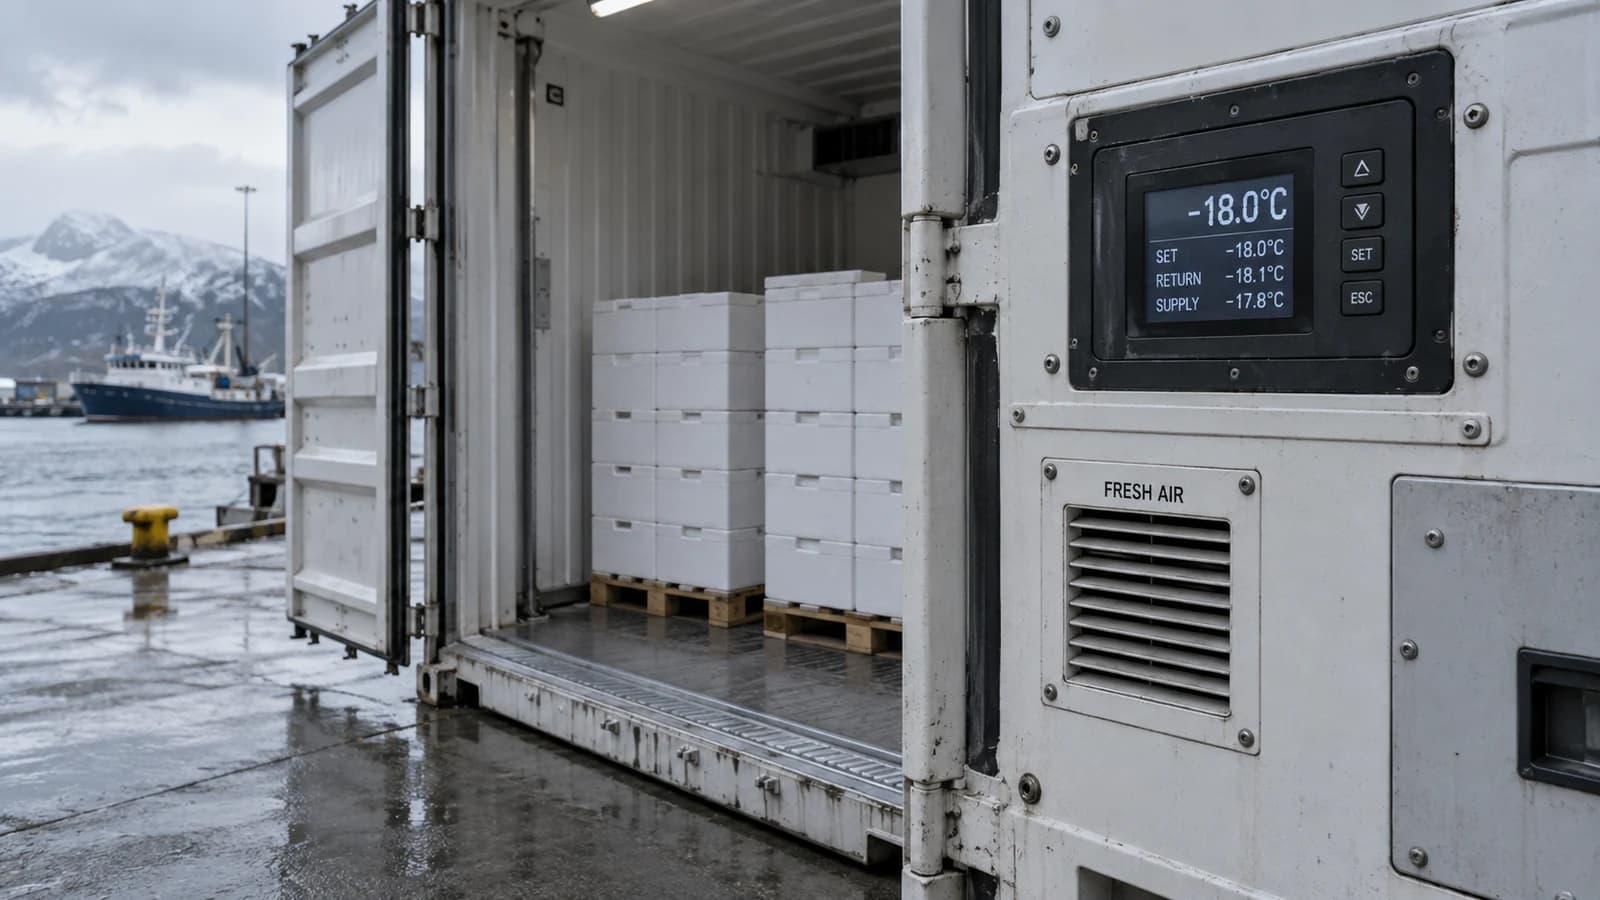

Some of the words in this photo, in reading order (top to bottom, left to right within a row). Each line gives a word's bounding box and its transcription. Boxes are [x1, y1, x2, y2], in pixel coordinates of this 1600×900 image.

[1187, 186, 1288, 227] -18.0°C
[1155, 248, 1178, 264] SET
[1225, 238, 1284, 258] -18.0°C
[1351, 247, 1374, 262] SET
[1156, 271, 1202, 288] RETURN
[1225, 264, 1284, 284] -18.1°C
[1156, 296, 1200, 313] SUPPLY
[1225, 290, 1284, 309] -17.8°C
[1350, 290, 1373, 305] ESC
[1104, 480, 1153, 501] FRESH
[1157, 484, 1184, 504] AIR
